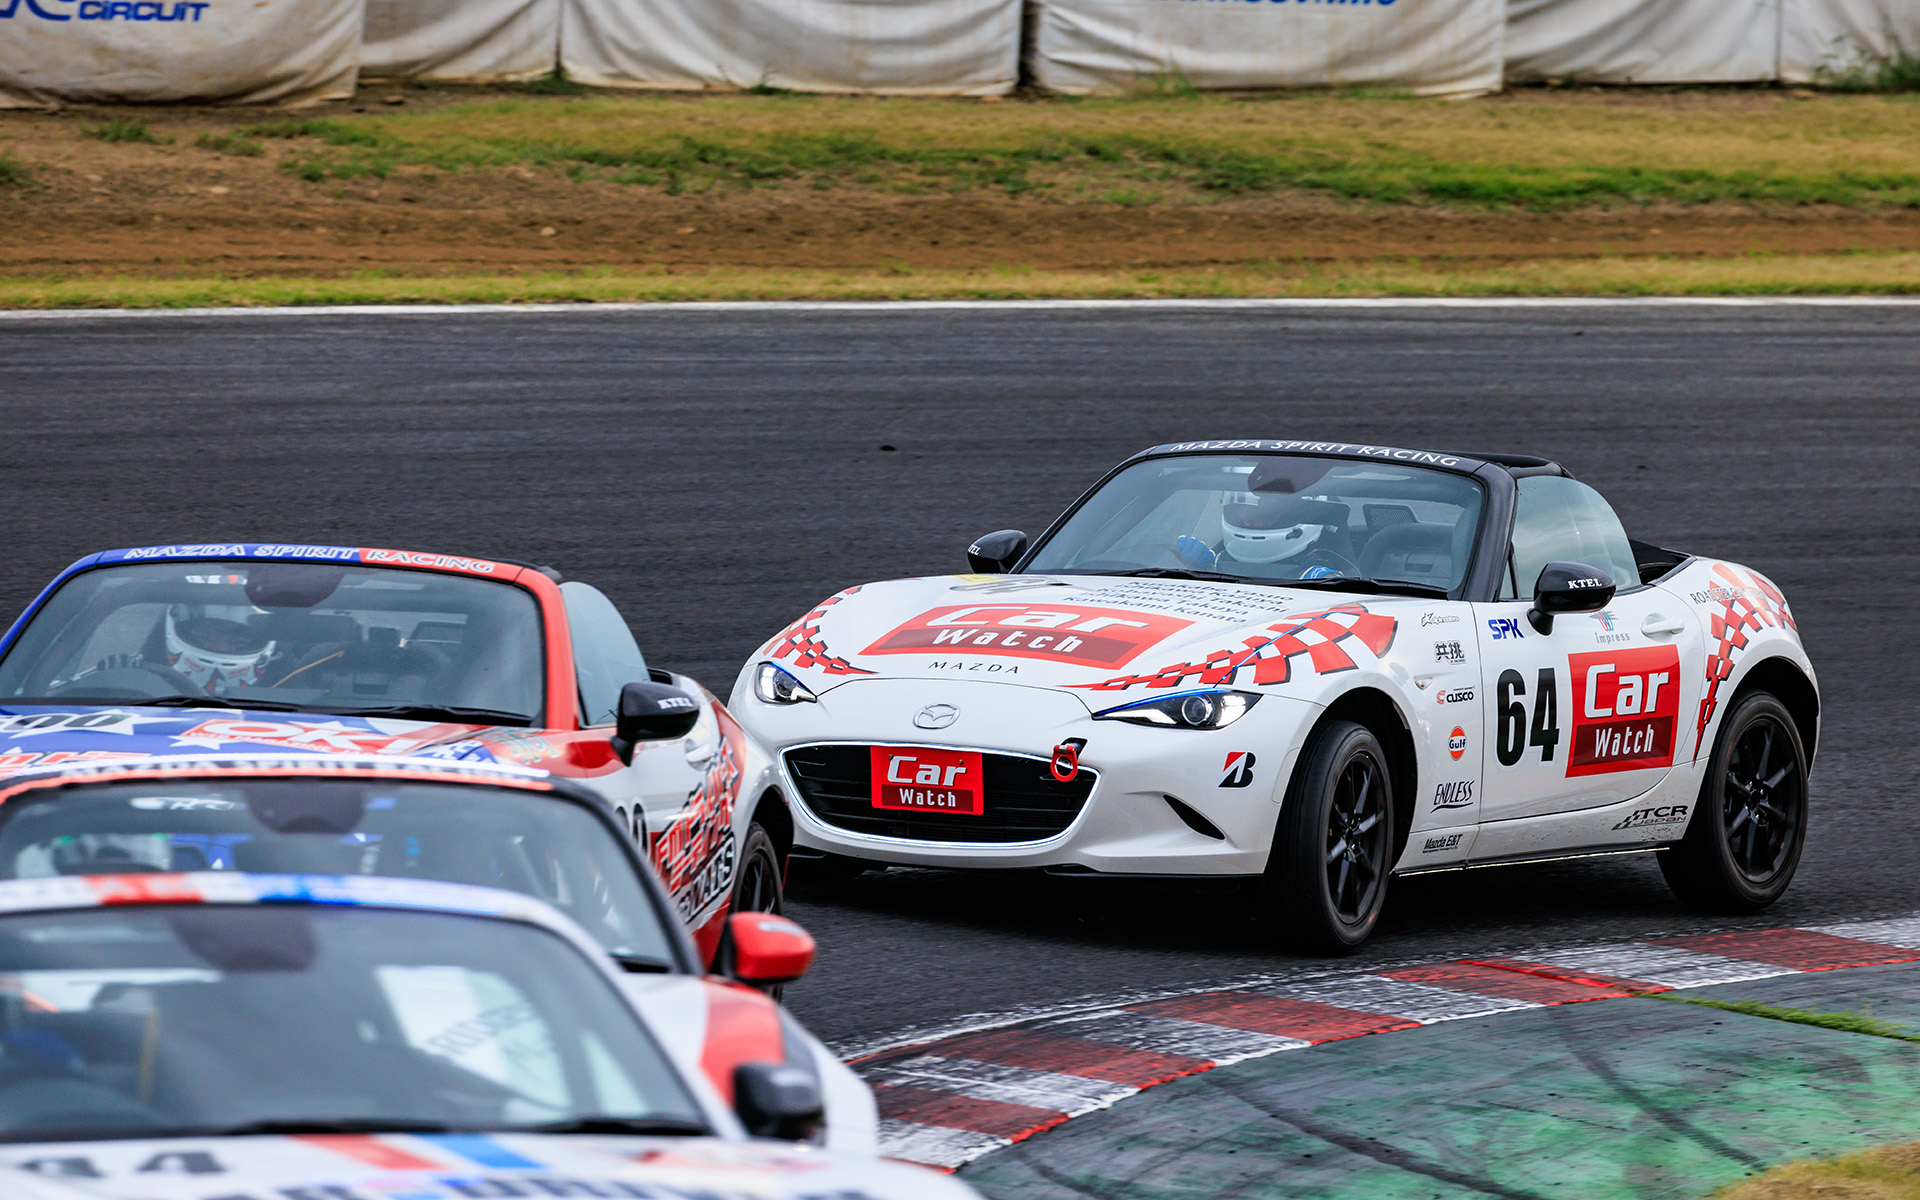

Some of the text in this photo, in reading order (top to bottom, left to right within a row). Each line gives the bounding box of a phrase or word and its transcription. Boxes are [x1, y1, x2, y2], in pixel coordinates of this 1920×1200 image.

[79, 0, 209, 22] CIRCUIT
[1170, 440, 1460, 466] MAZDA SPIRIT RACING
[124, 545, 496, 573] MAZDA SPIRIT RACING
[1567, 578, 1603, 589] KTEL
[926, 605, 1148, 632] Car
[1173, 607, 1248, 623] Kanata
[932, 627, 1084, 653] Watch
[1488, 618, 1525, 640] SPK
[1594, 631, 1631, 644] impress
[1435, 641, 1465, 661] 共挑
[929, 660, 1019, 675] MAZDA
[1584, 662, 1669, 718] Car
[1497, 667, 1560, 767] 64
[1449, 738, 1466, 749] Gulf
[1594, 724, 1655, 759] Watch
[887, 755, 966, 787] Car
[899, 787, 956, 807] Watch
[1433, 780, 1475, 806] ENDLESS
[1640, 805, 1689, 820] TCR
[1423, 837, 1447, 850] Mazda
[1445, 833, 1463, 847] E&T
